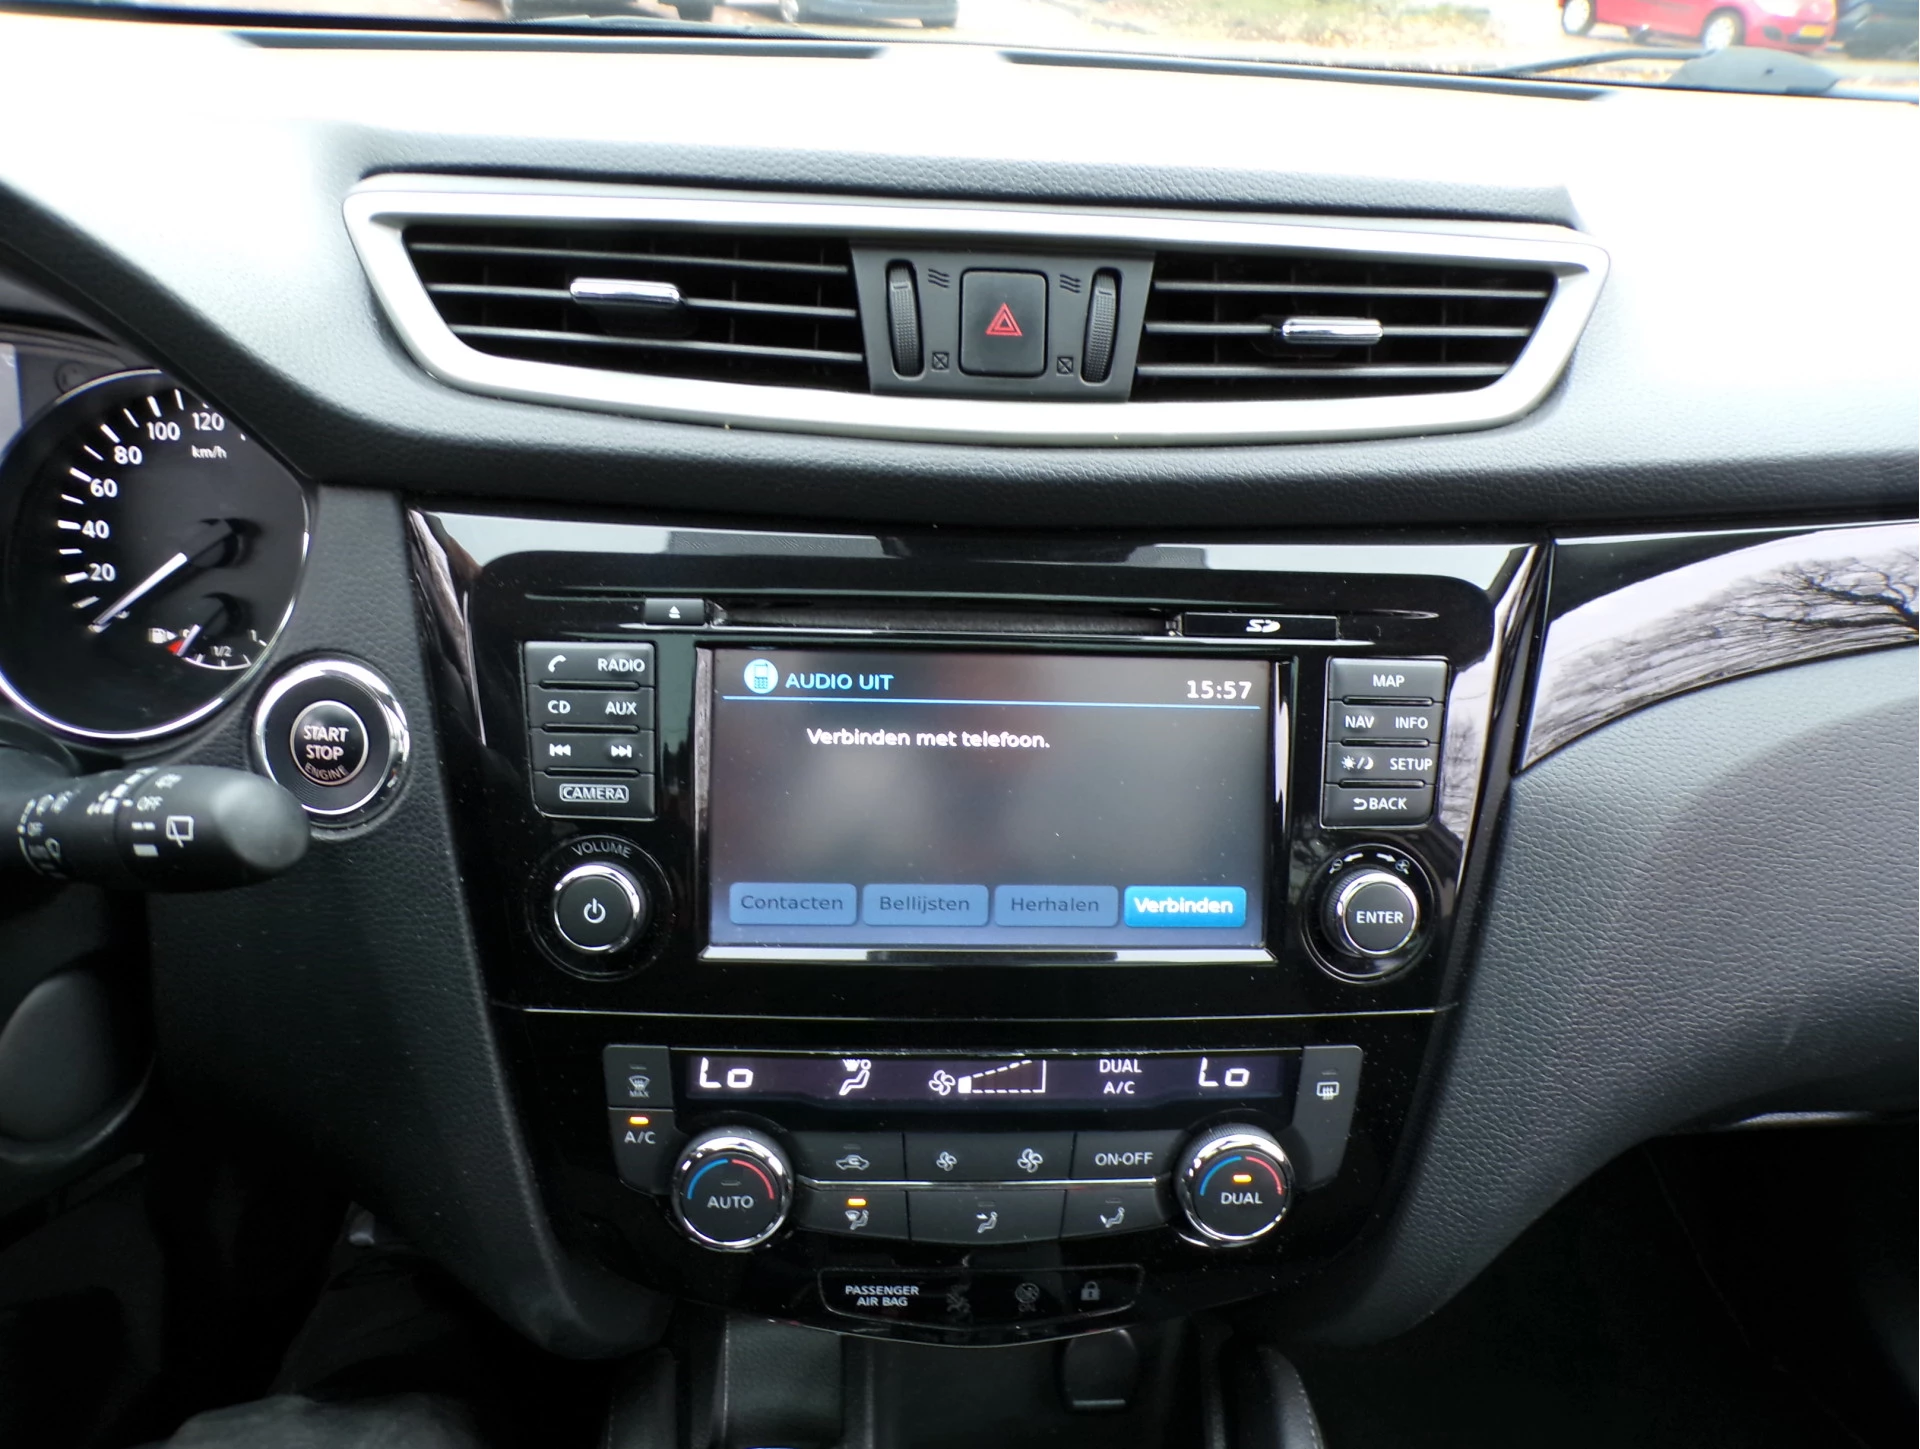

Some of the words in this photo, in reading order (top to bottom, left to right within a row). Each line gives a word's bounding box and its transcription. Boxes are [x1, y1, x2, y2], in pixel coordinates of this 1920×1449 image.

[192, 412, 225, 431] 120
[147, 421, 181, 441] 100
[114, 445, 143, 465] 80
[191, 445, 227, 459] km/h
[90, 478, 118, 498] 60
[82, 520, 110, 539] 40
[89, 563, 116, 582] 20
[598, 657, 646, 673] RADIO
[785, 673, 853, 690] AUDIO
[859, 674, 894, 690] UIT
[1373, 674, 1405, 688] MAP
[1186, 680, 1252, 700] 15:57
[548, 701, 571, 715] CD
[605, 701, 637, 716] AUX
[1345, 715, 1375, 730] NAV
[1395, 717, 1429, 731] INFO
[303, 725, 349, 742] START
[806, 728, 910, 748] Verbinden
[916, 732, 957, 748] met
[962, 731, 1051, 749] telefoon.
[306, 744, 344, 761] STOP
[1389, 757, 1433, 772] SETUP
[563, 786, 625, 801] CAMERA
[1369, 796, 1408, 810] BACK
[572, 842, 631, 858] VOLUME
[740, 895, 844, 911] Contacten
[879, 895, 970, 916] Bellijsten
[1010, 896, 1099, 913] Herhalen
[1134, 897, 1234, 914] Verbinden
[1356, 910, 1404, 925] ENTER
[1099, 1059, 1142, 1074] DUAL
[1104, 1081, 1135, 1096] A/C
[624, 1130, 656, 1145] A/C
[707, 1195, 754, 1209] AUTO
[1220, 1191, 1263, 1206] DUAL
[845, 1285, 919, 1296] PASSENGER
[856, 1296, 881, 1307] AIR
[882, 1296, 908, 1307] BAG
